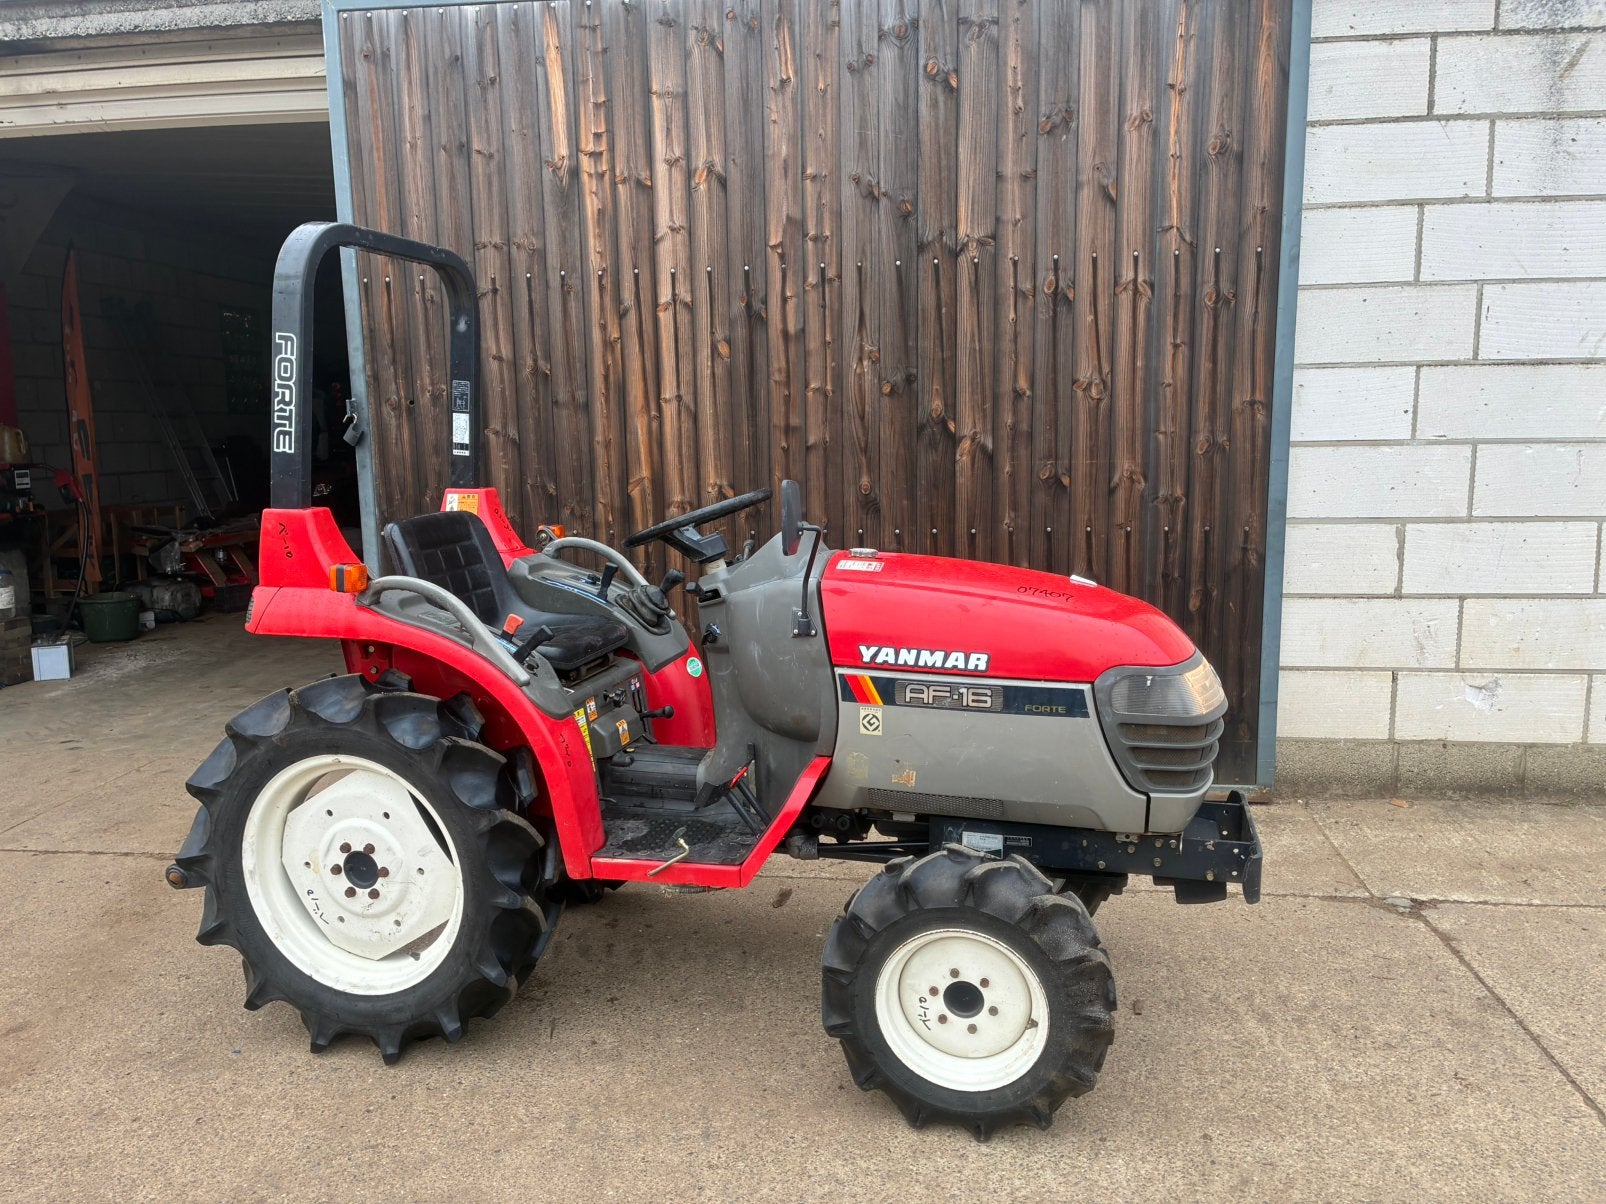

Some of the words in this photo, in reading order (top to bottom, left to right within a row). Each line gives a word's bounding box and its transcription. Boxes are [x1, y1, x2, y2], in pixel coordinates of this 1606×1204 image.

[273, 332, 297, 454] FORTE
[858, 644, 991, 673] YANMAR
[1024, 704, 1067, 714] FORTE
